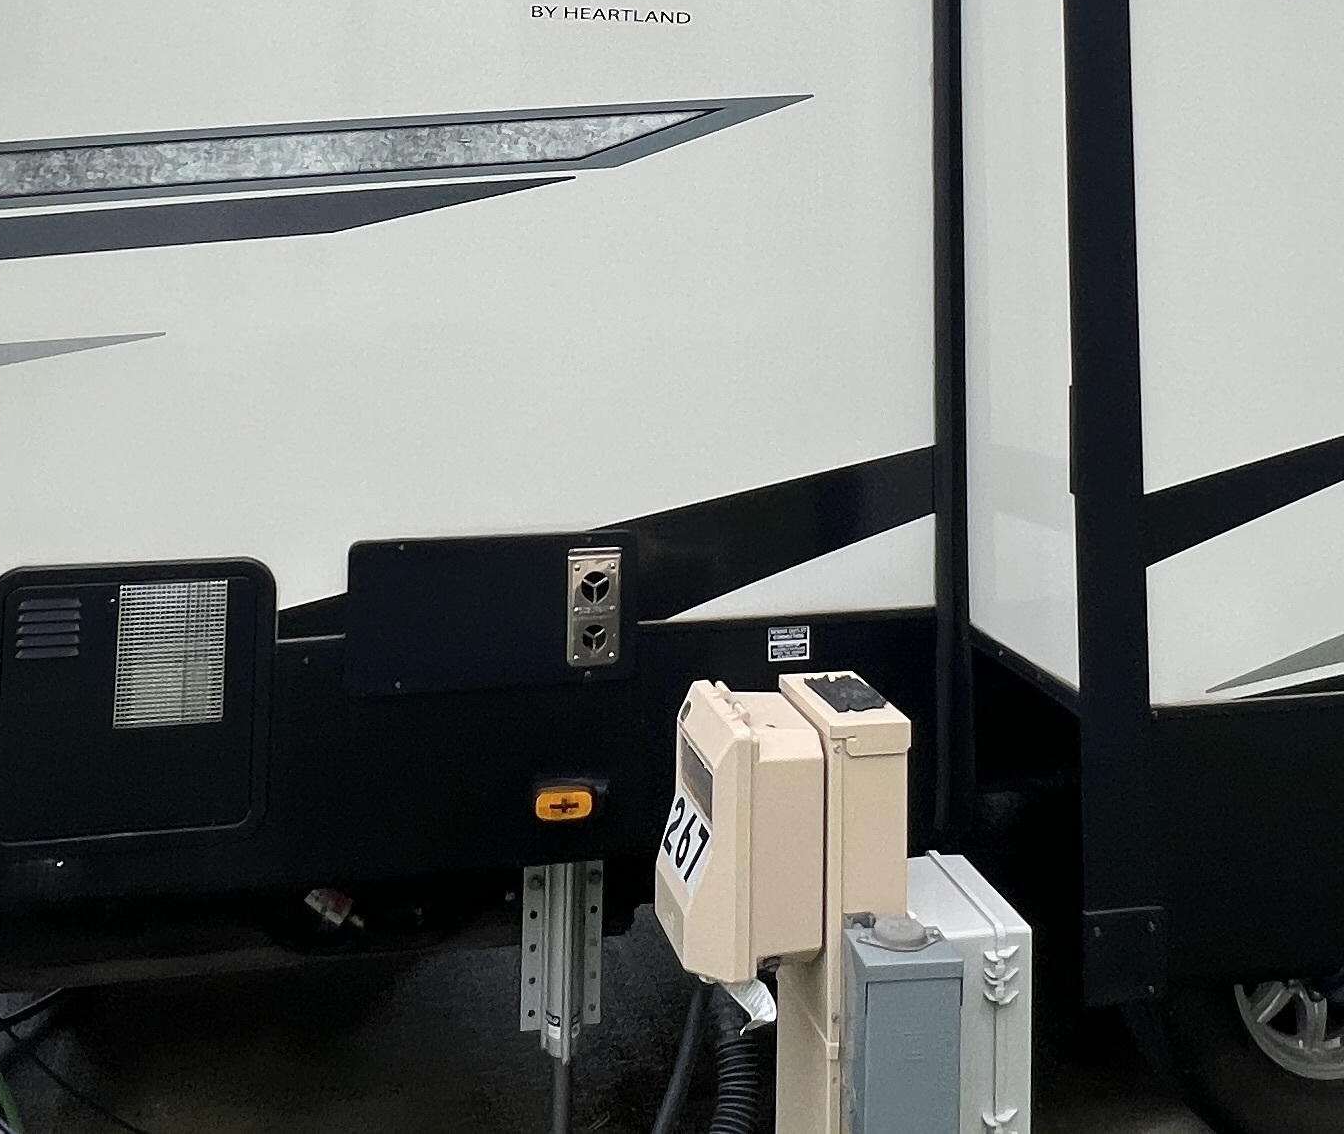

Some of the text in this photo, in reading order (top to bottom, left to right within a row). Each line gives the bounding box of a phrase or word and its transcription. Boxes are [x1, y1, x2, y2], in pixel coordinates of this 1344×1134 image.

[531, 5, 692, 25] BY HEARTLAND
[663, 796, 711, 884] 267
